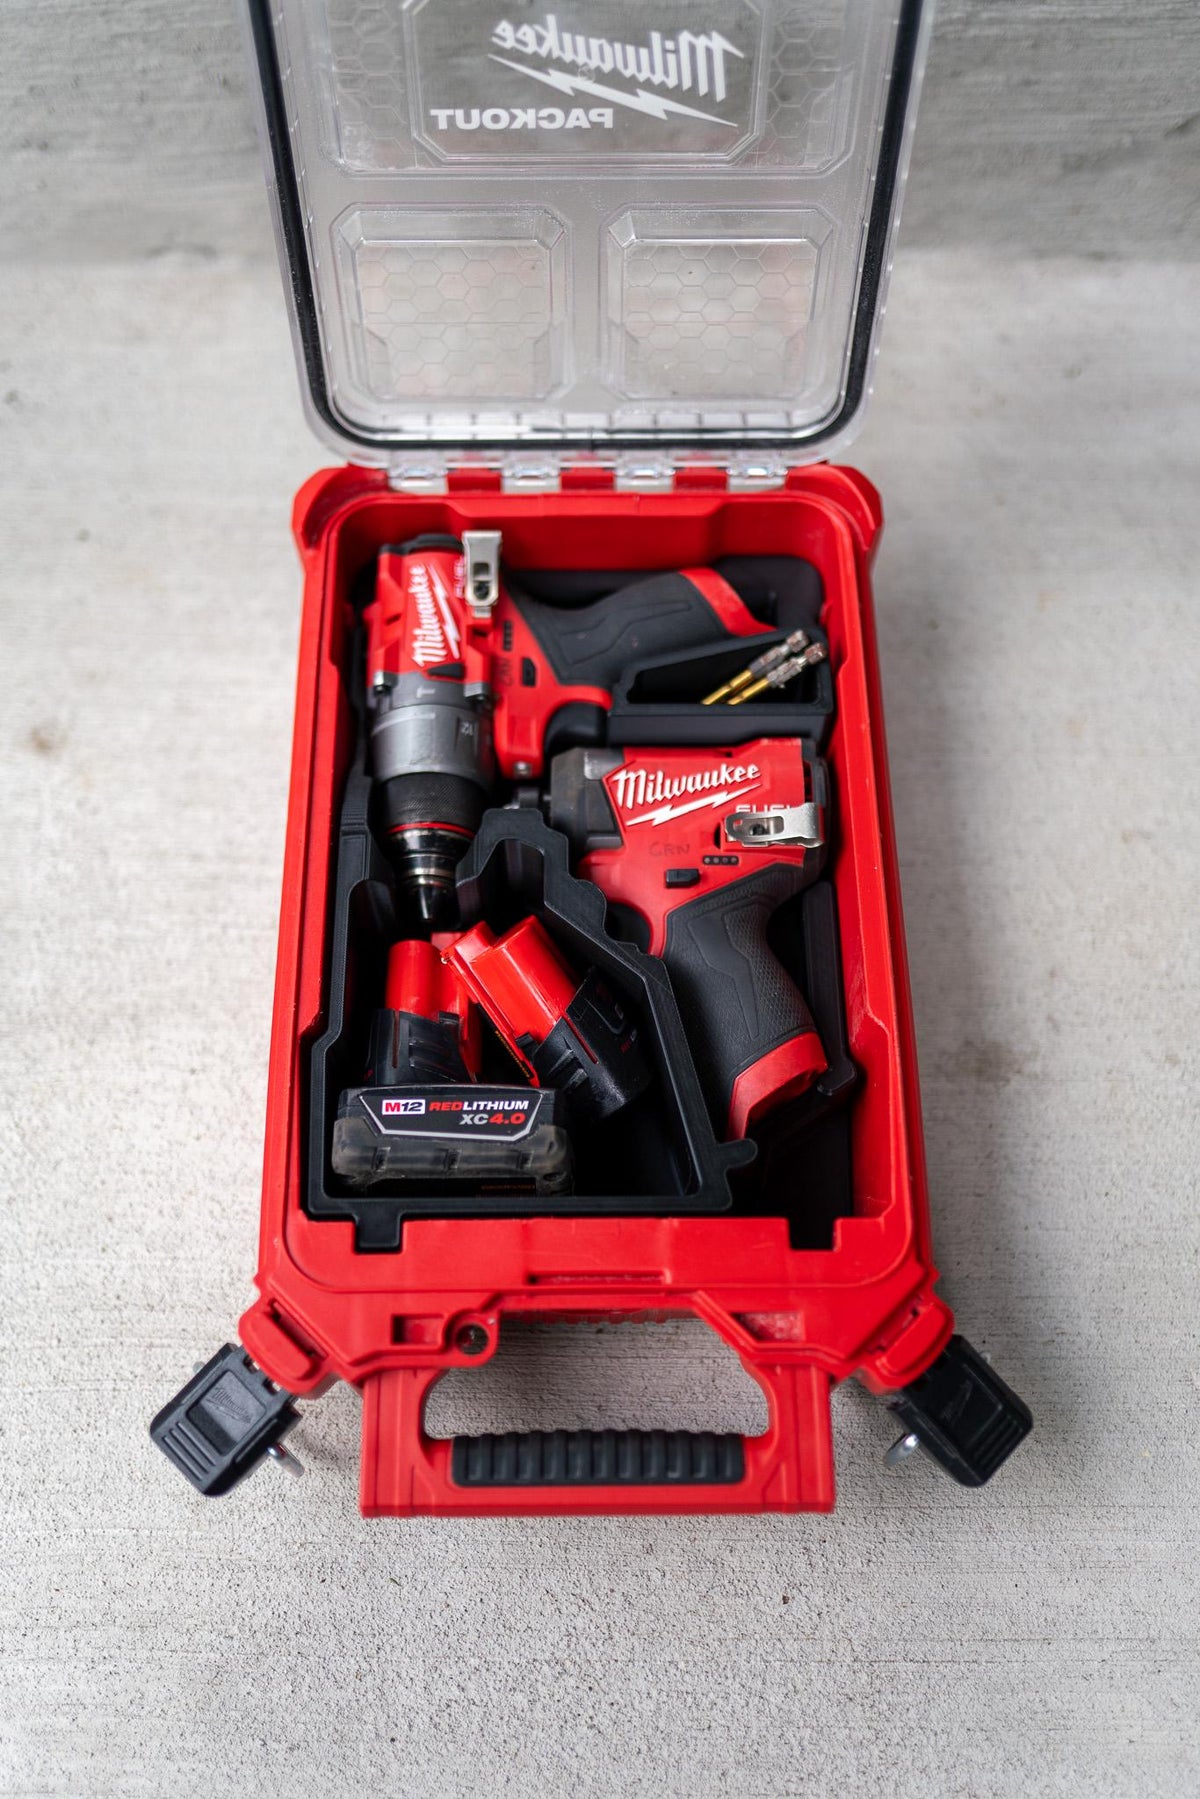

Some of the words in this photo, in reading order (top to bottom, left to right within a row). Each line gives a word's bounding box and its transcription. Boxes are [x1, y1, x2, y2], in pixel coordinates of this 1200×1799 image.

[408, 564, 447, 667] Milwaukee
[613, 763, 760, 809] Milwaukee
[384, 1101, 424, 1113] M12
[429, 1101, 529, 1111] REDLITHIUM
[459, 1112, 526, 1125] XC4.0
